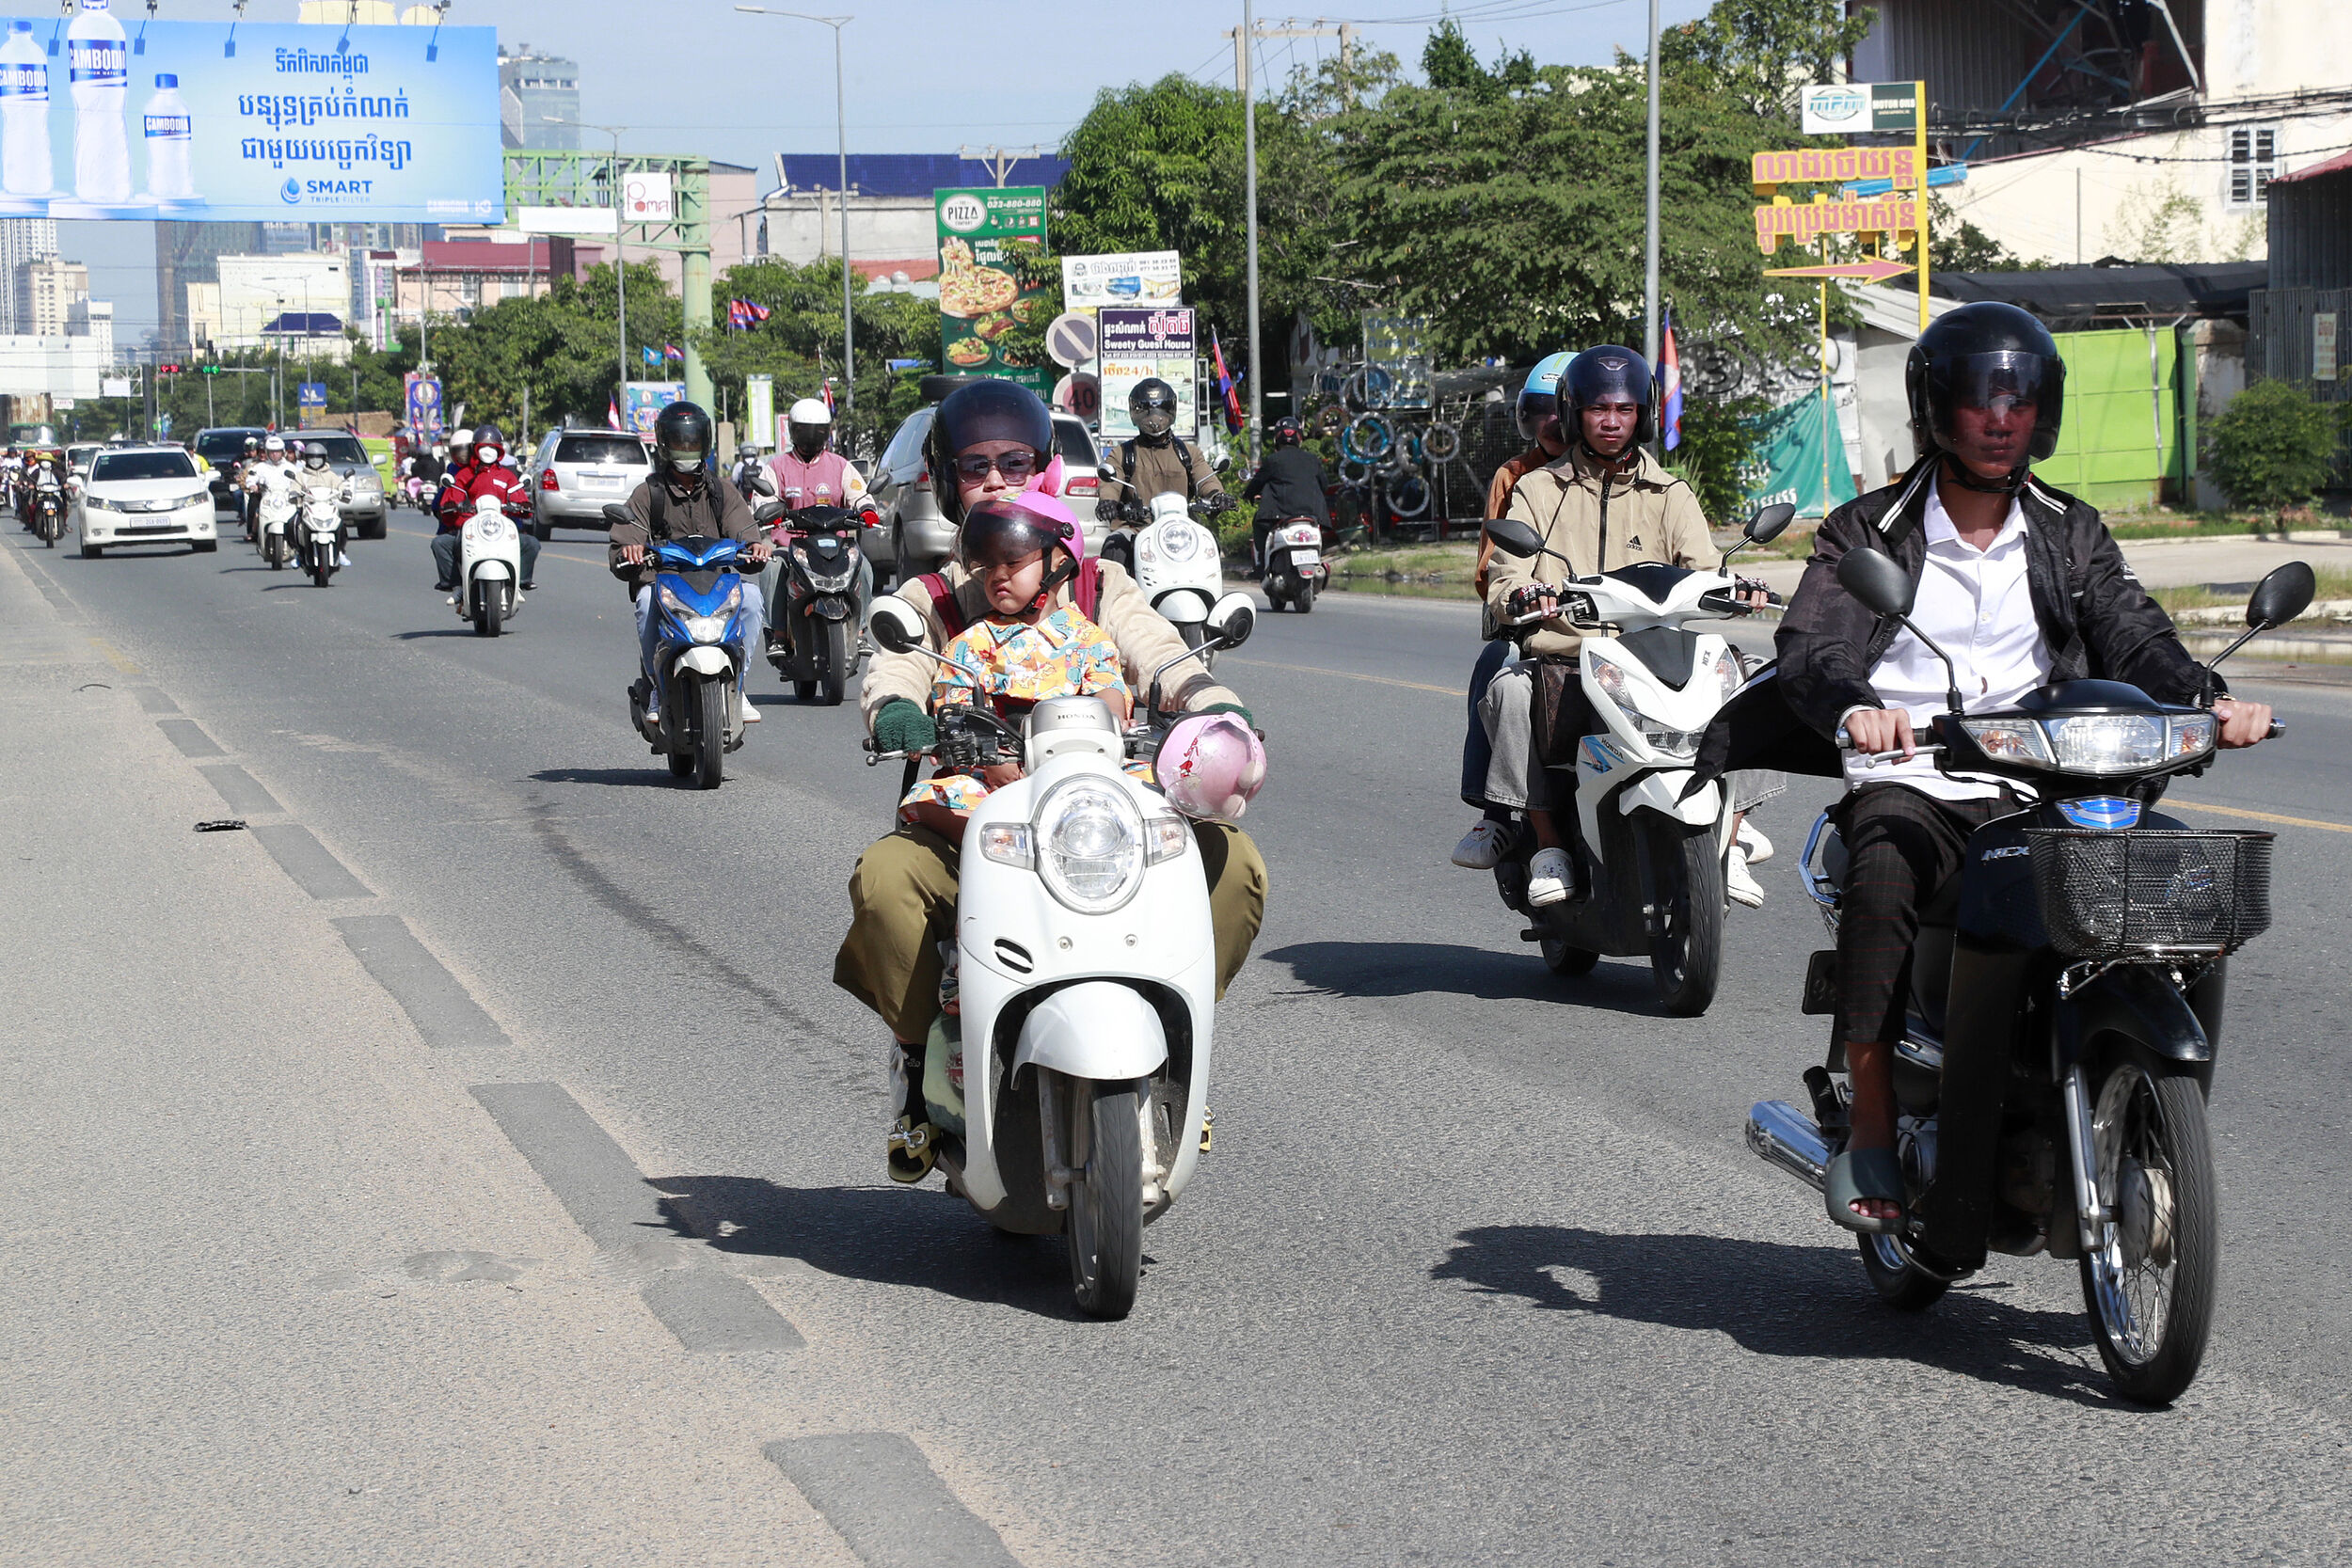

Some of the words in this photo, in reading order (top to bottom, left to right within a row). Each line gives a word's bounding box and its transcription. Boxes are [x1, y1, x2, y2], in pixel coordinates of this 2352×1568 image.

[146, 117, 188, 132] CAMBODIA
[307, 181, 373, 194] SMART
[947, 207, 978, 220] PIZZA
[1104, 340, 1136, 351] Sweety
[1137, 339, 1163, 349] Guest
[1164, 340, 1191, 349] House
[1069, 388, 1096, 410] 40
[1601, 737, 1624, 759] HONDA
[1981, 847, 2030, 861] NCX
